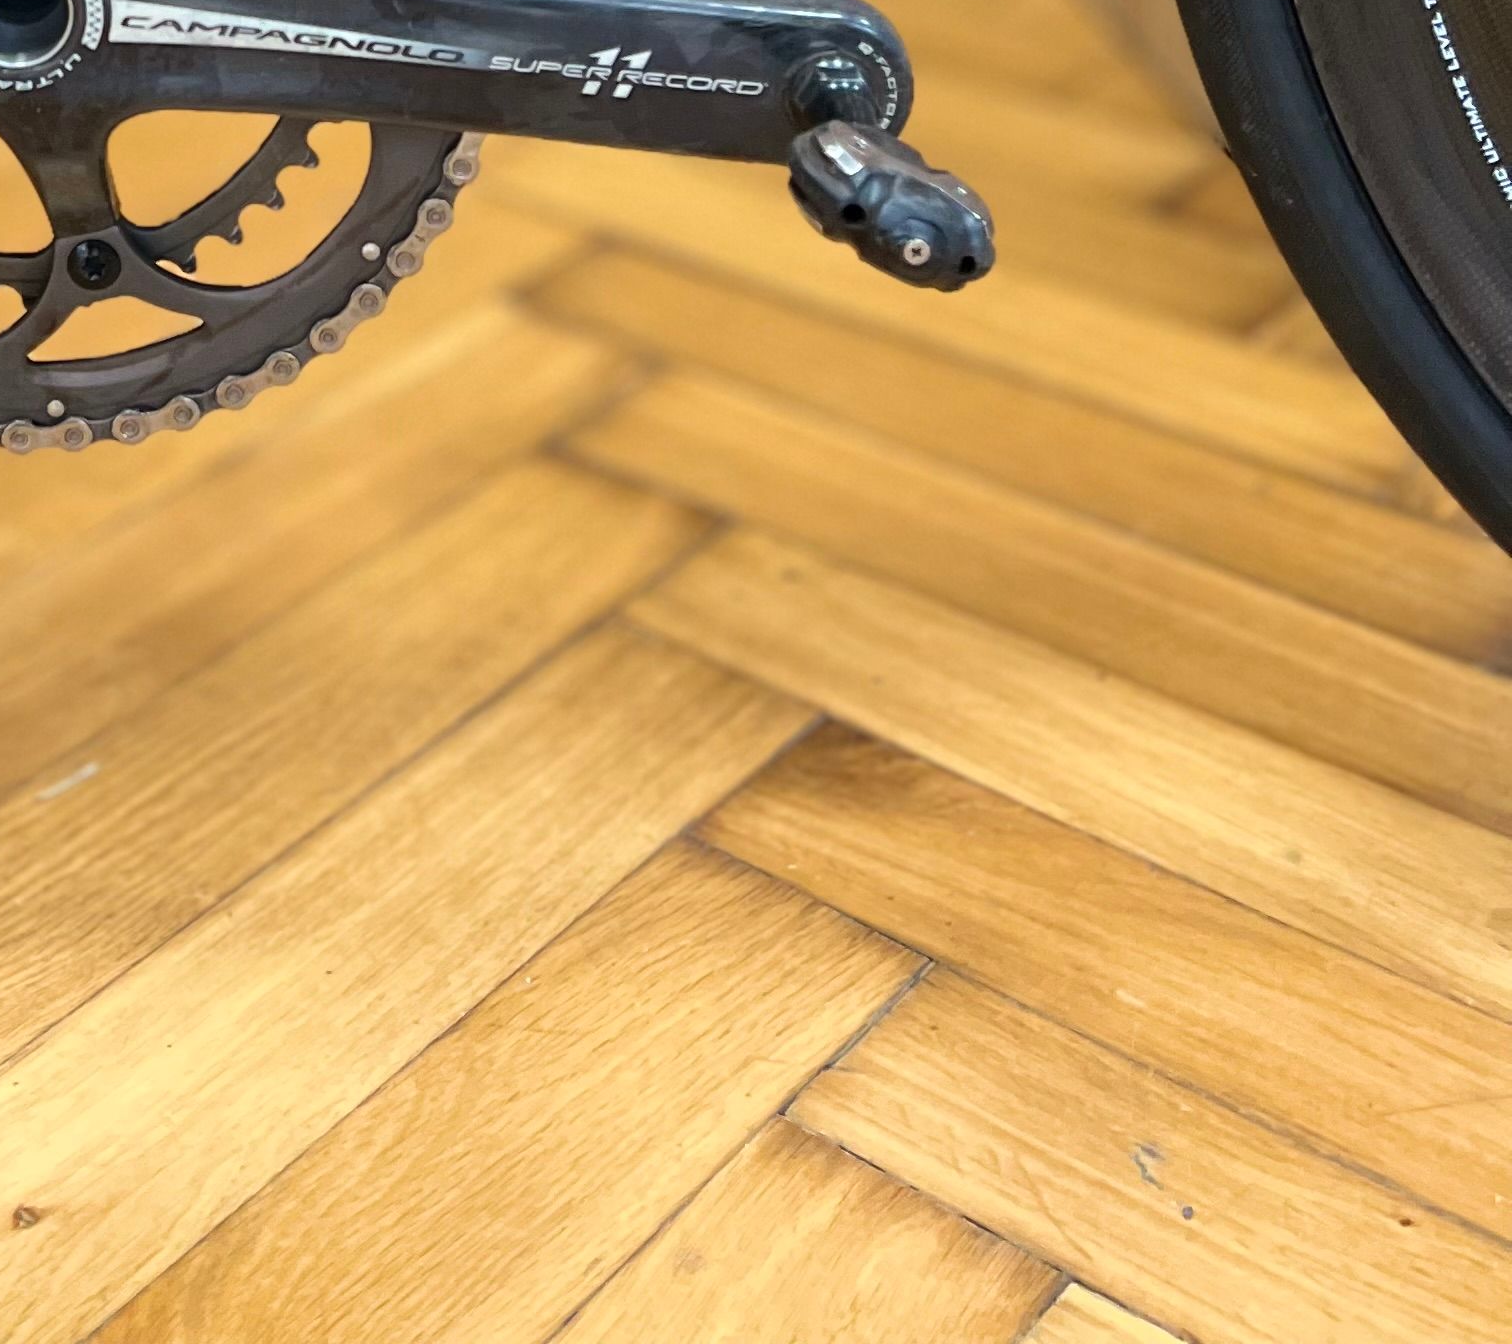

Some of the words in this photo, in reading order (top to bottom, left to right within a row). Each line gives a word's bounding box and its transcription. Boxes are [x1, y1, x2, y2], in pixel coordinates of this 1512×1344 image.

[119, 14, 464, 64] CAMPAGNOLO
[1431, 11, 1460, 72] LEVEL
[488, 55, 610, 80] SUPER
[615, 69, 764, 96] RECORD
[1452, 74, 1499, 164] ULTIMATE
